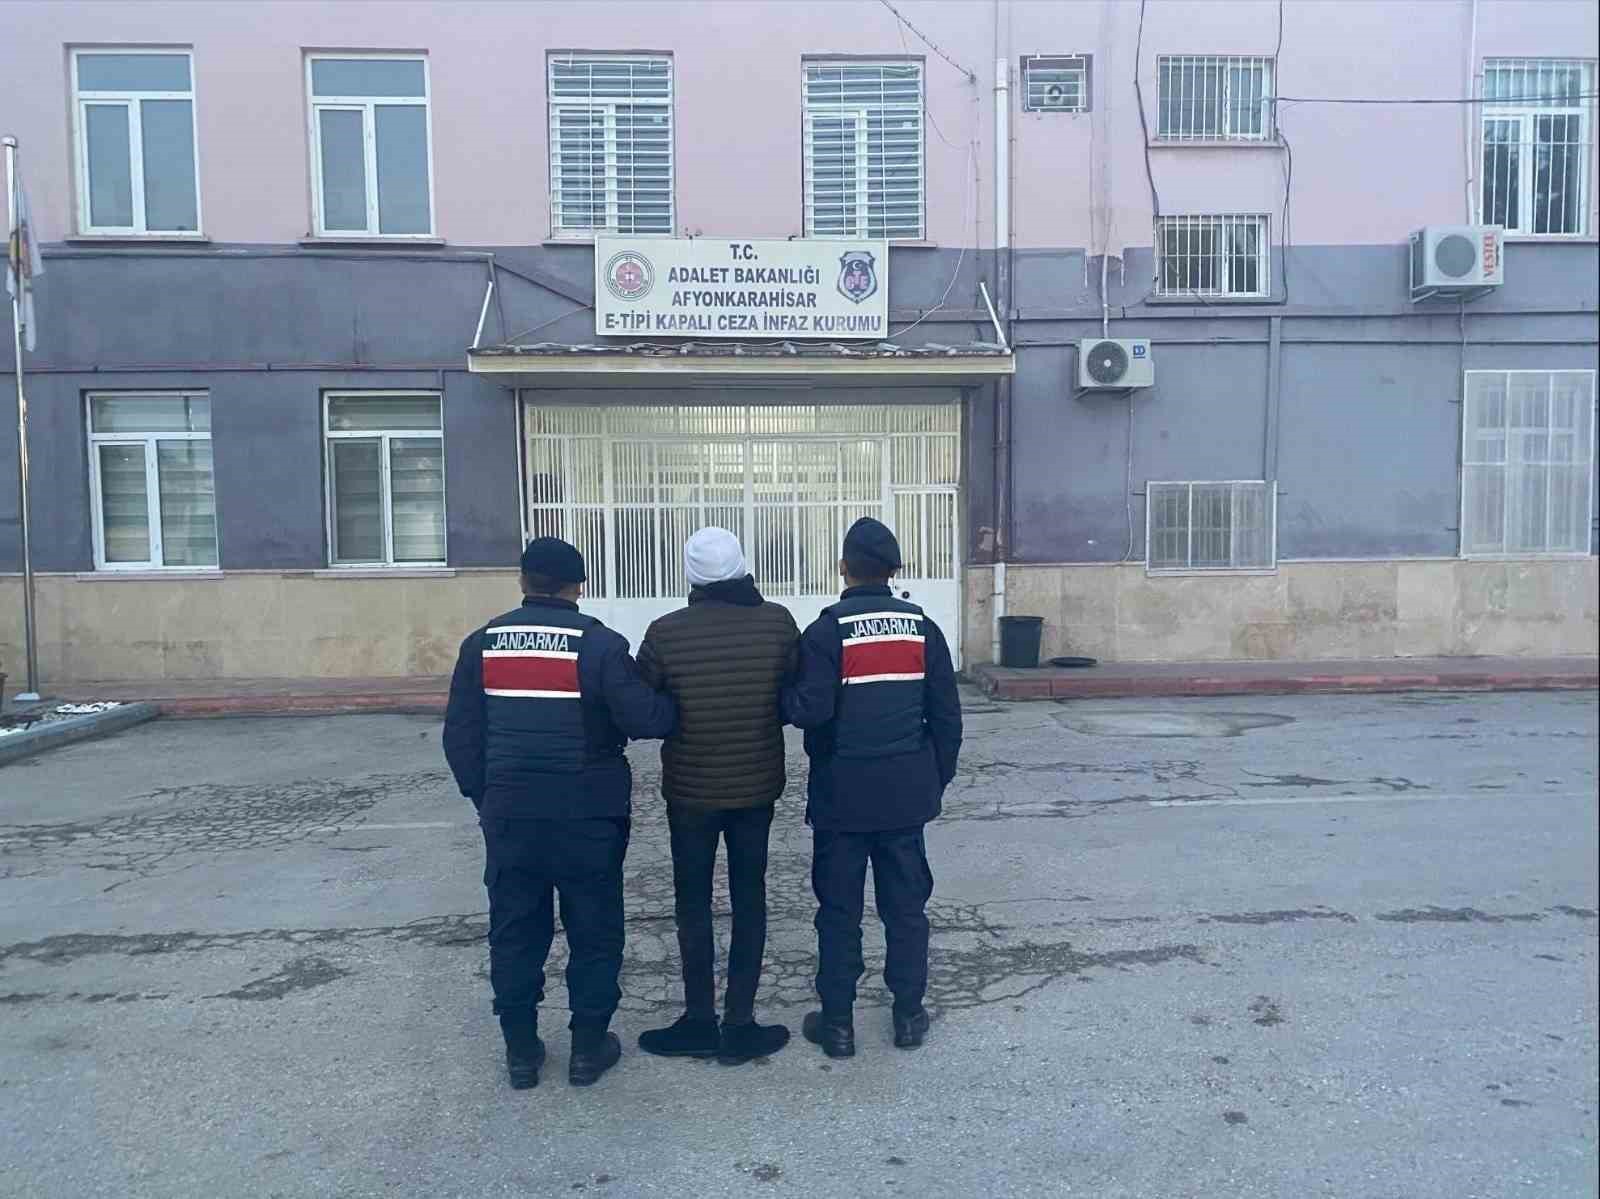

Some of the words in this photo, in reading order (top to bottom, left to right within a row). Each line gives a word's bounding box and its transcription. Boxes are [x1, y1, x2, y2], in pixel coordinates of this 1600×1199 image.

[729, 244, 758, 260] T.C.
[1483, 233, 1497, 278] VESTEL
[668, 267, 729, 283] ADALET
[734, 265, 820, 285] BAKANLIĞI
[671, 288, 817, 308] AFYONKARAHİSAR
[605, 309, 651, 329] E-TİPİ
[655, 313, 712, 330] KAPALI
[717, 314, 759, 331] CEZA
[763, 311, 809, 331] İNFAZ
[813, 315, 882, 332] KURUMU
[851, 618, 918, 637] JANDARMA
[491, 632, 569, 651] JANDARMA
